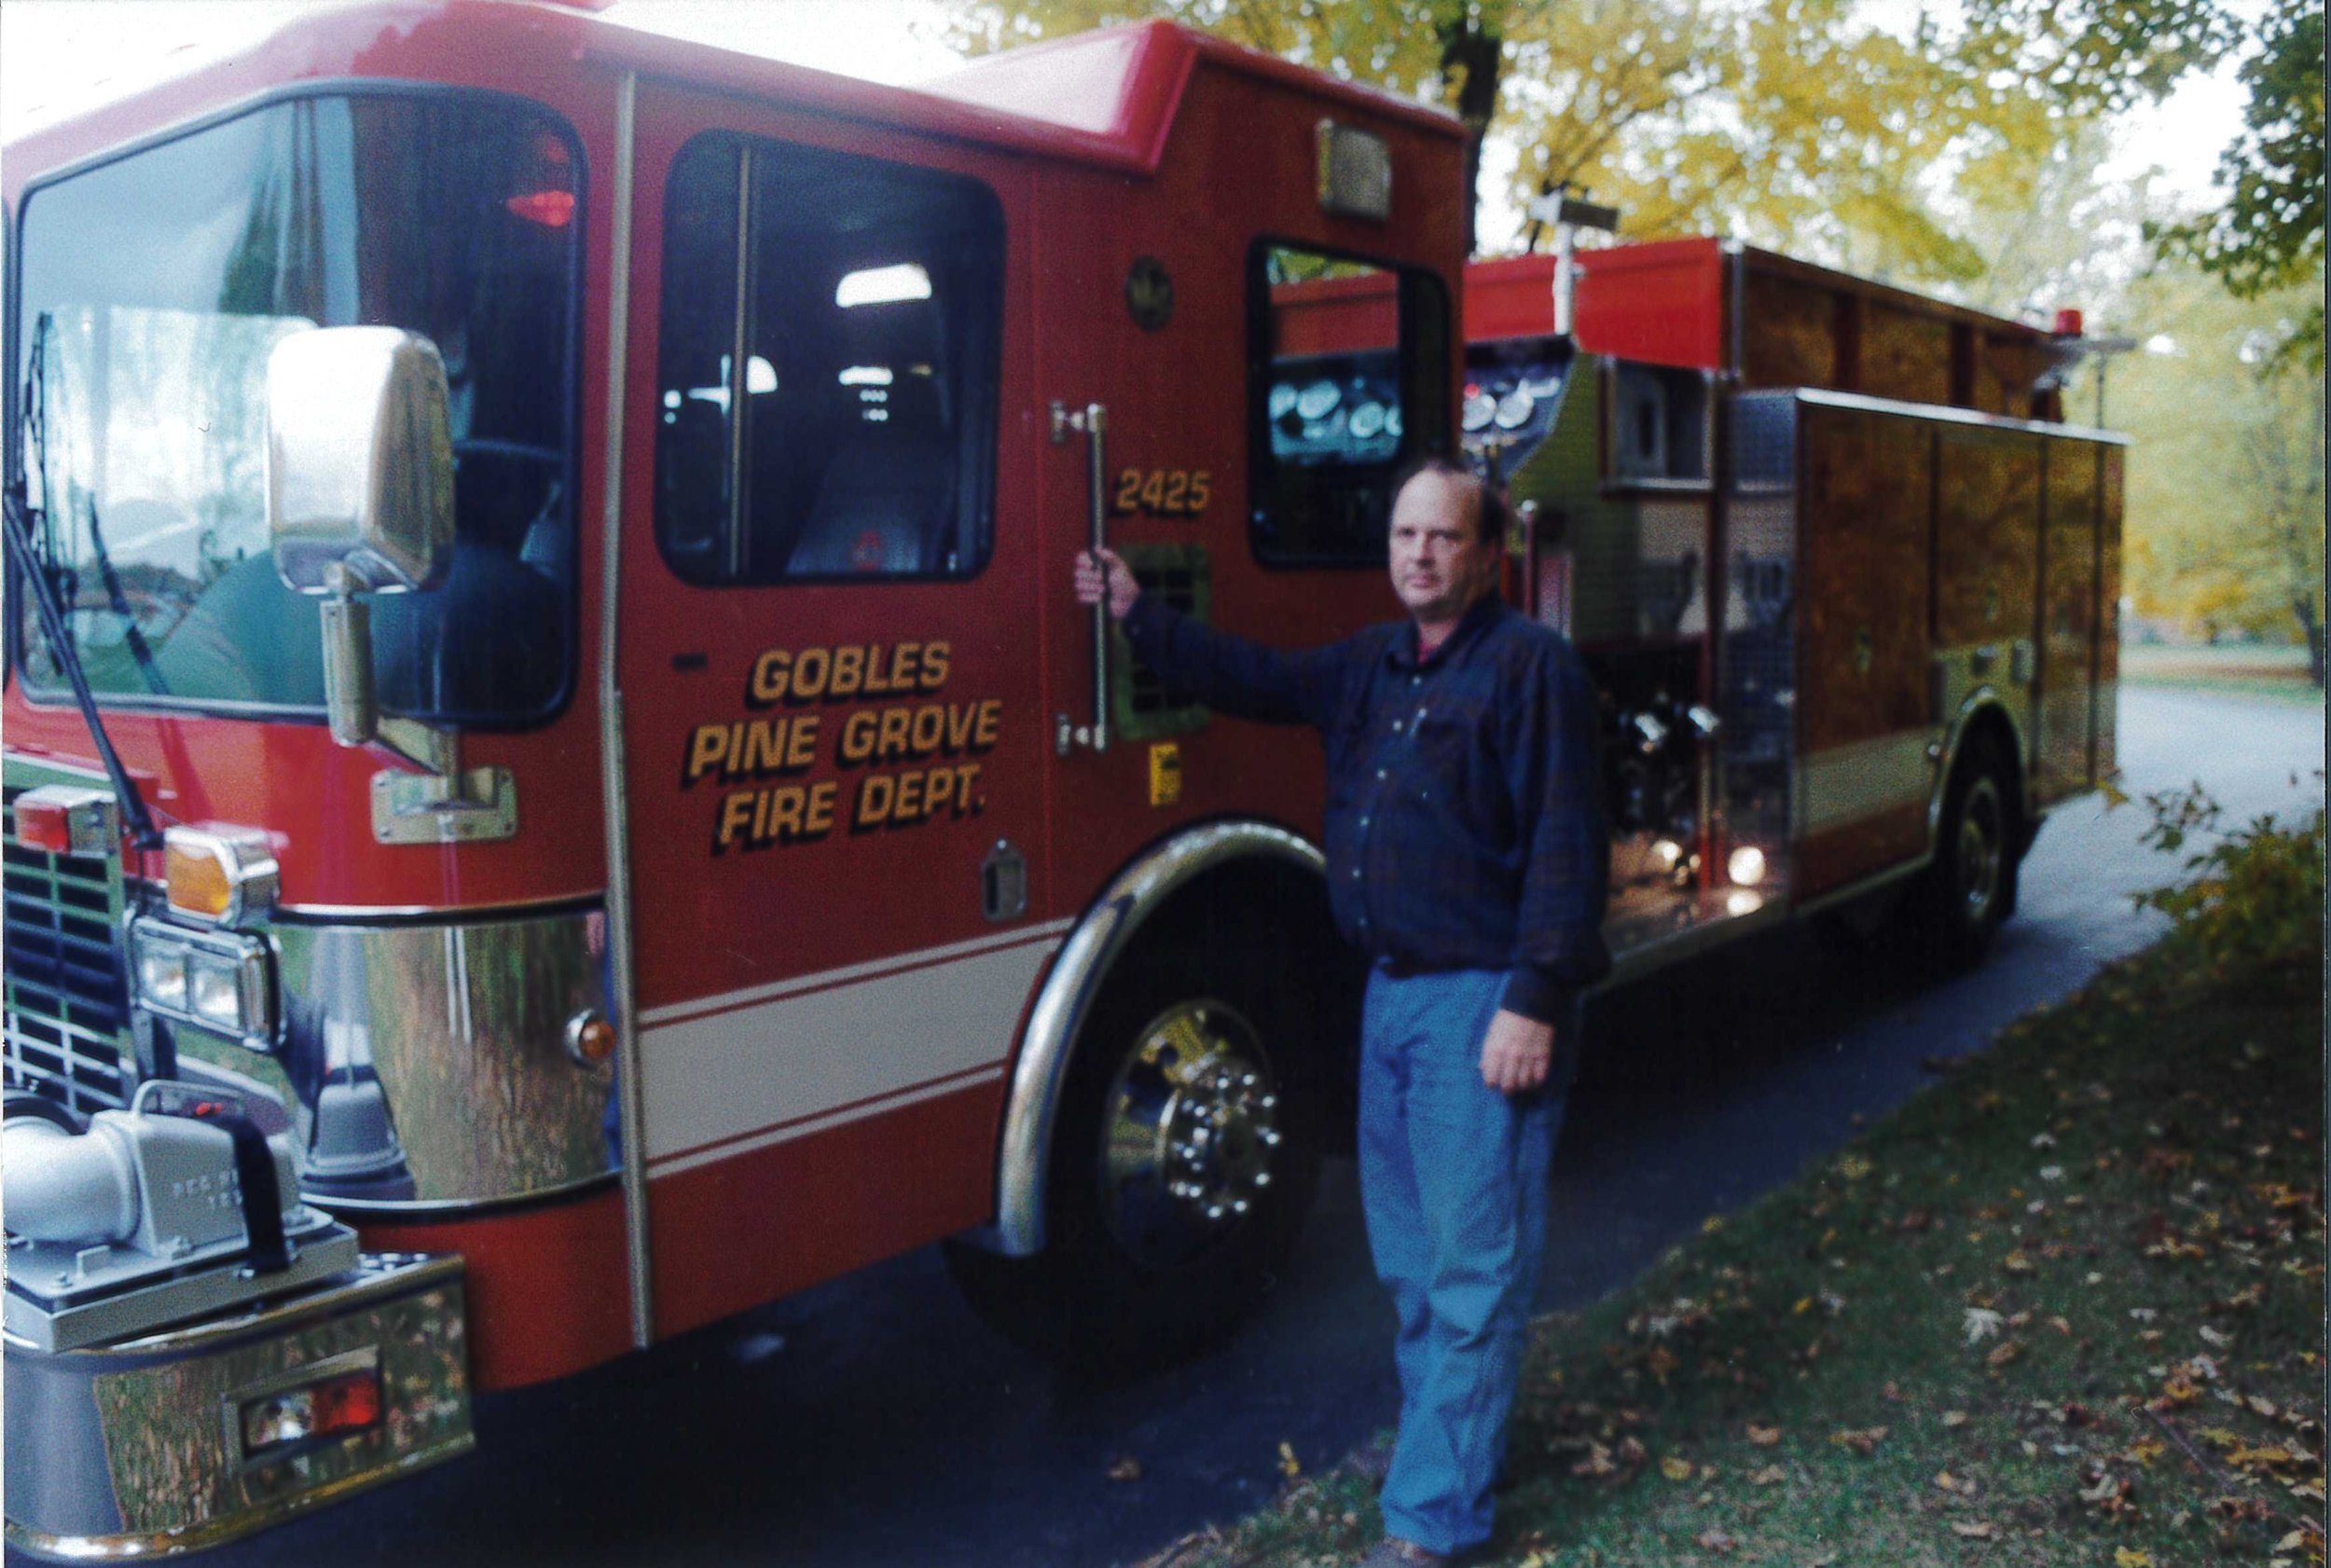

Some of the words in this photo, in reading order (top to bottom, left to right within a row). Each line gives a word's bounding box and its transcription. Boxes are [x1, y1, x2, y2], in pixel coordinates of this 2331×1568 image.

[1115, 467, 1211, 513] 2425
[750, 640, 950, 706] GOBLES
[683, 715, 821, 785] PINE
[839, 698, 1003, 764] GROVE
[713, 781, 838, 850] FIRE
[853, 763, 986, 832] DEPT.
